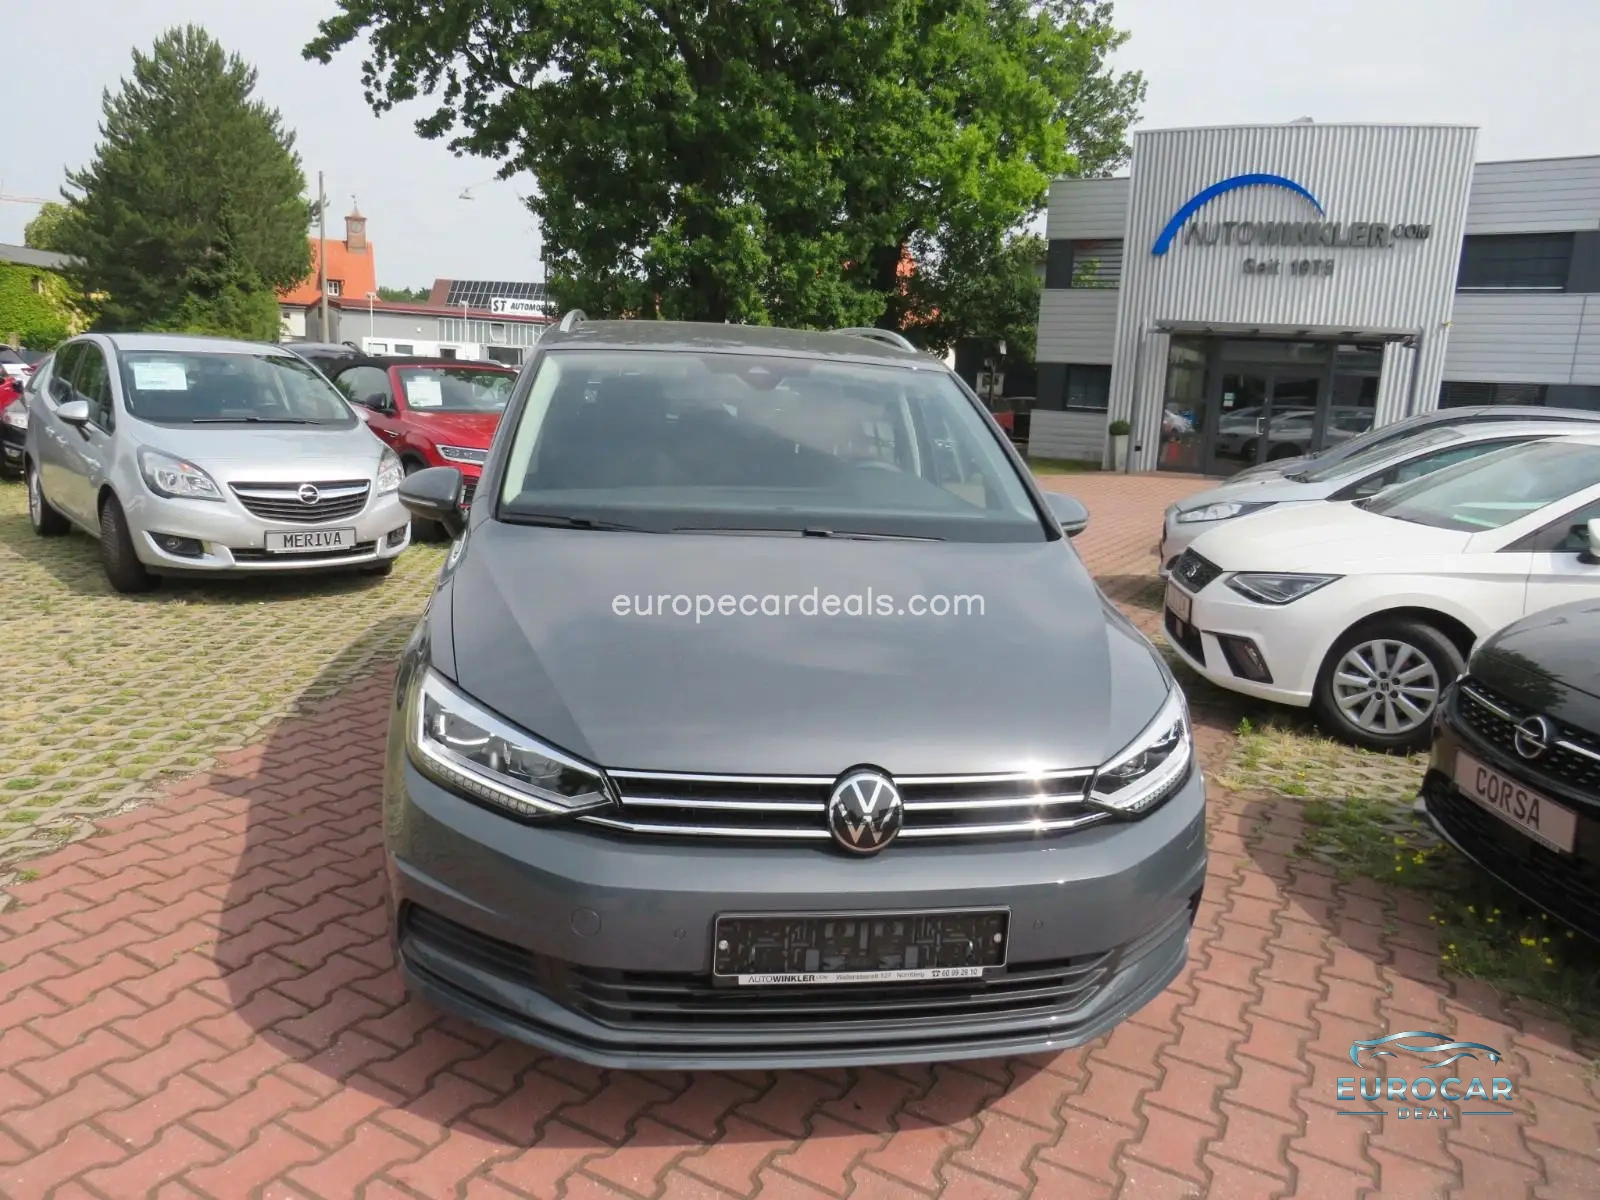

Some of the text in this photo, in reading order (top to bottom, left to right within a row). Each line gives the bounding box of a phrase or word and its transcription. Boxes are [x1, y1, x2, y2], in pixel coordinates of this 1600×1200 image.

[493, 300, 507, 312] ST
[283, 532, 342, 548] MERIVA
[1475, 766, 1541, 831] CORSA
